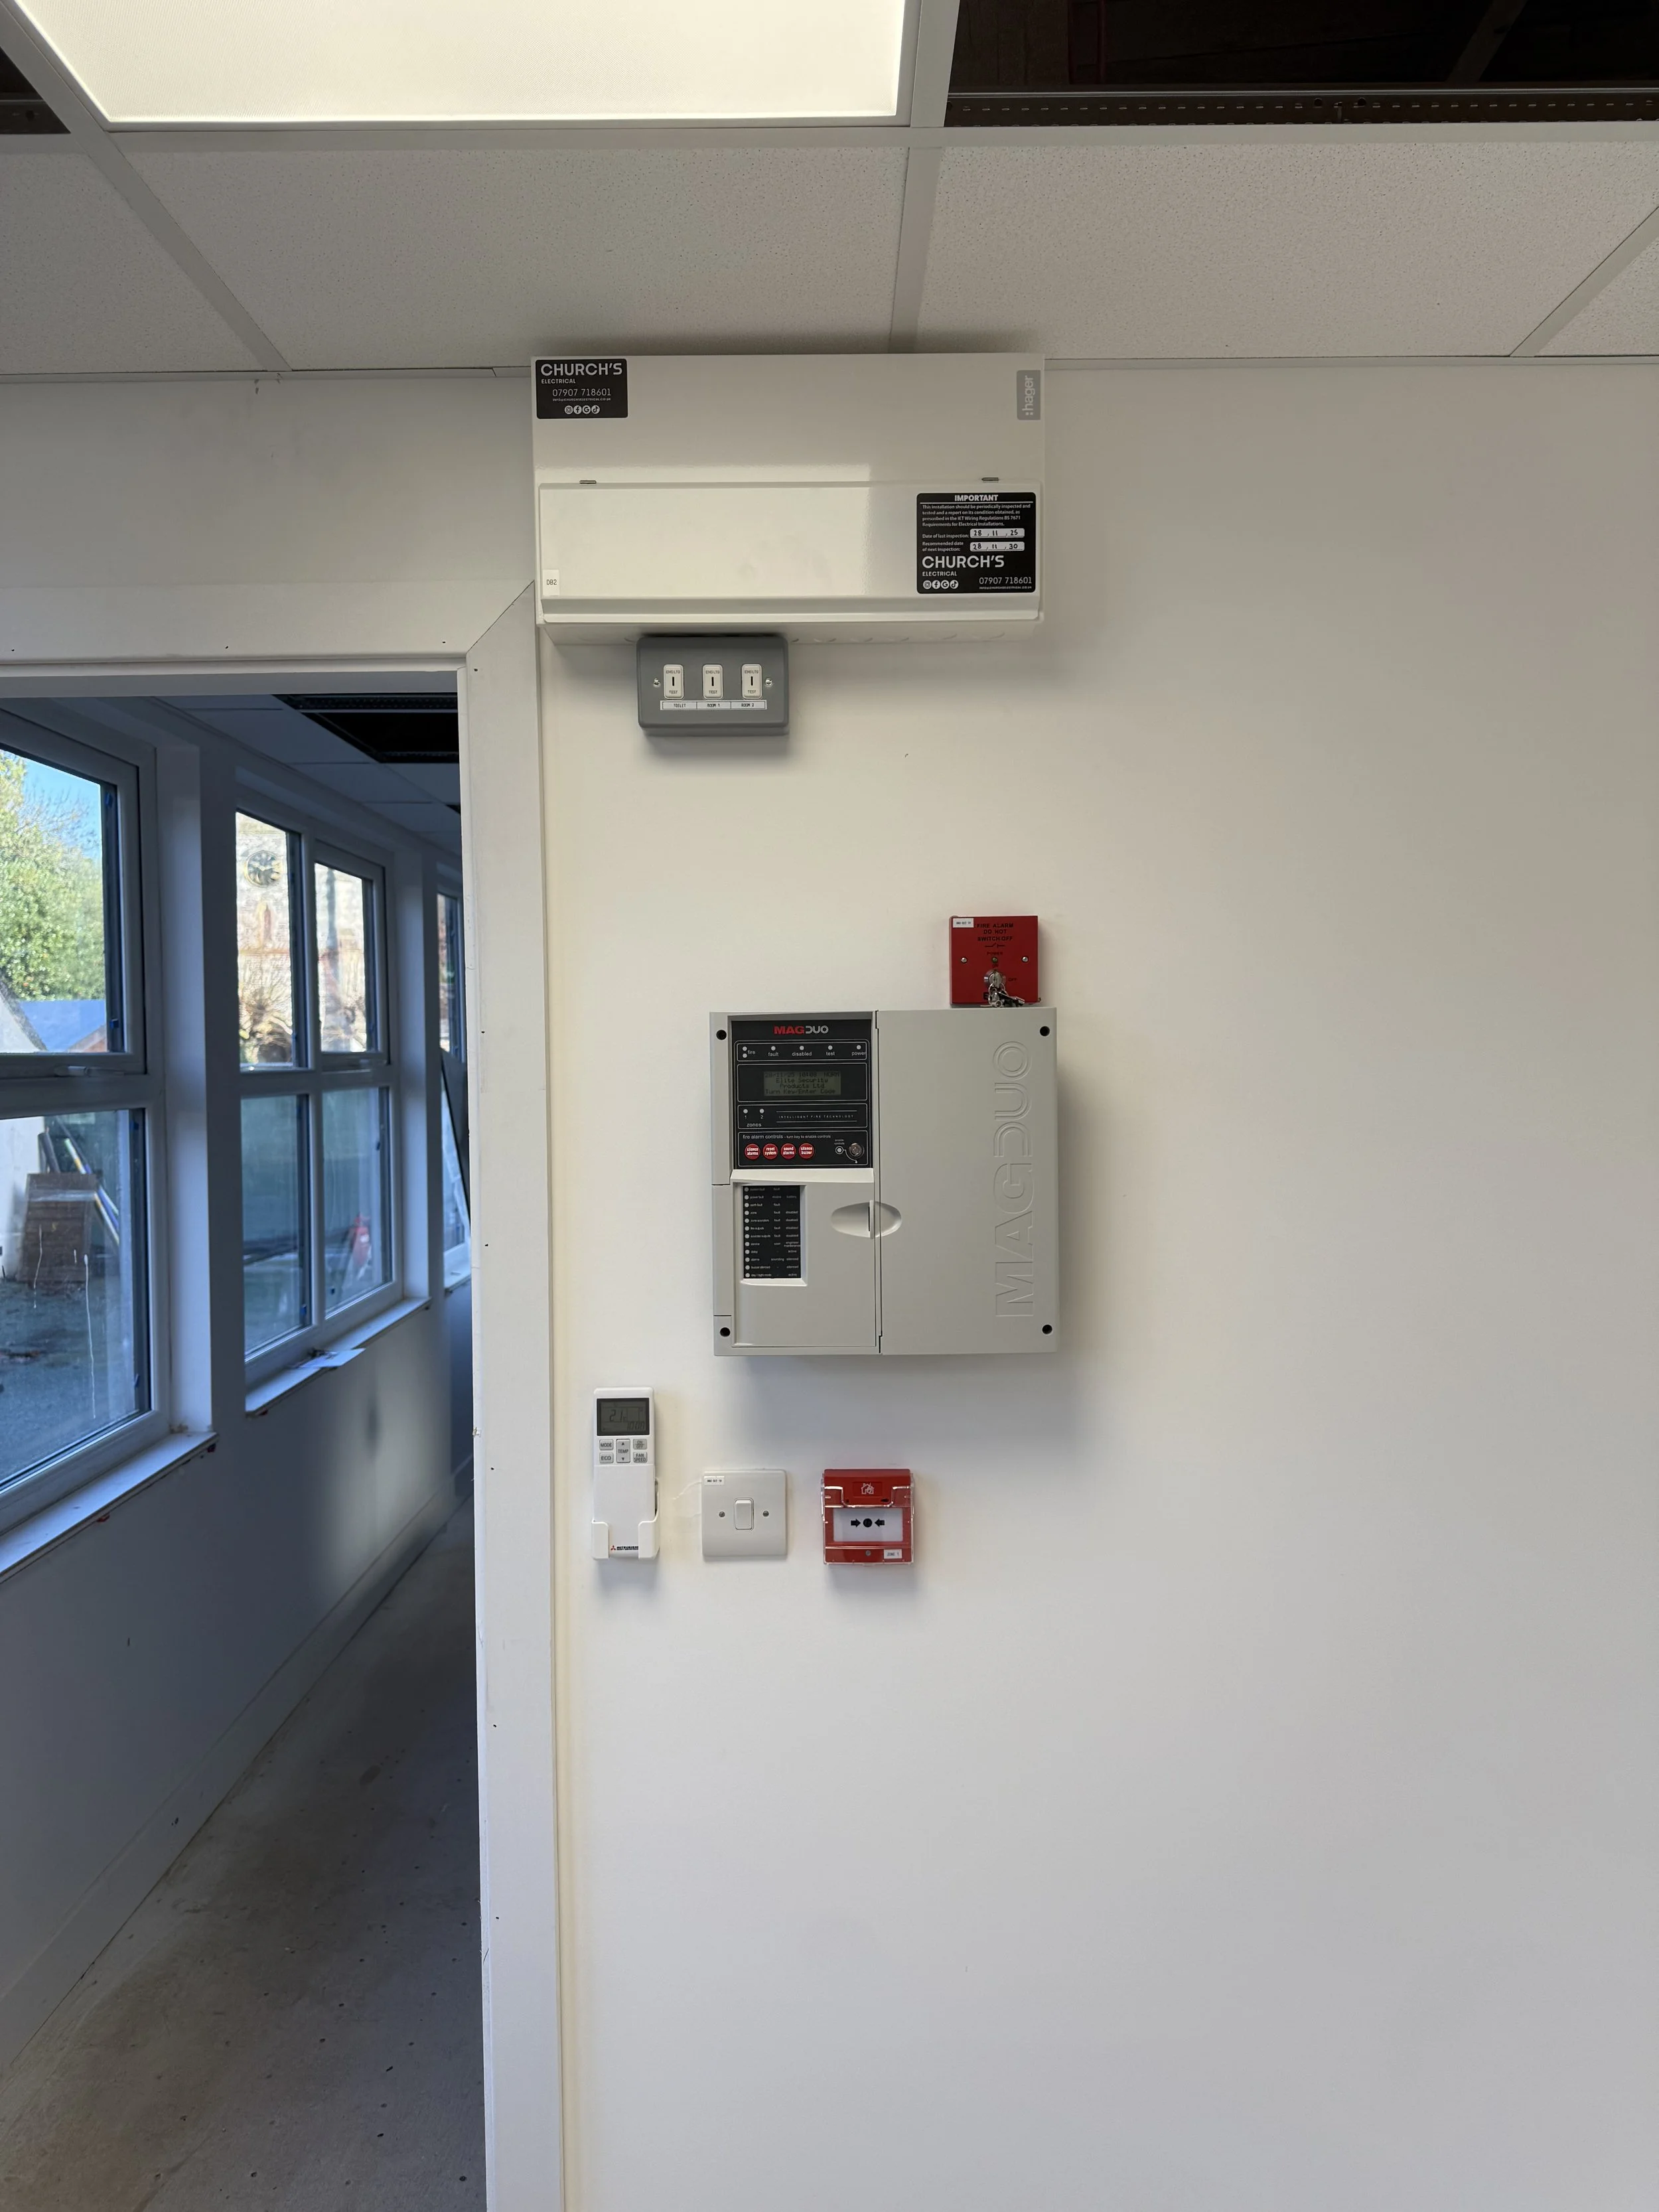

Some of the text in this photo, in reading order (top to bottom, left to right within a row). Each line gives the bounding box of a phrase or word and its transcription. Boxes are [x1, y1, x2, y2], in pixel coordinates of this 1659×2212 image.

[540, 362, 623, 376] CHURCH'S
[552, 388, 578, 397] 07907
[1022, 375, 1035, 411] hager
[922, 555, 1005, 569] CHURCH'S
